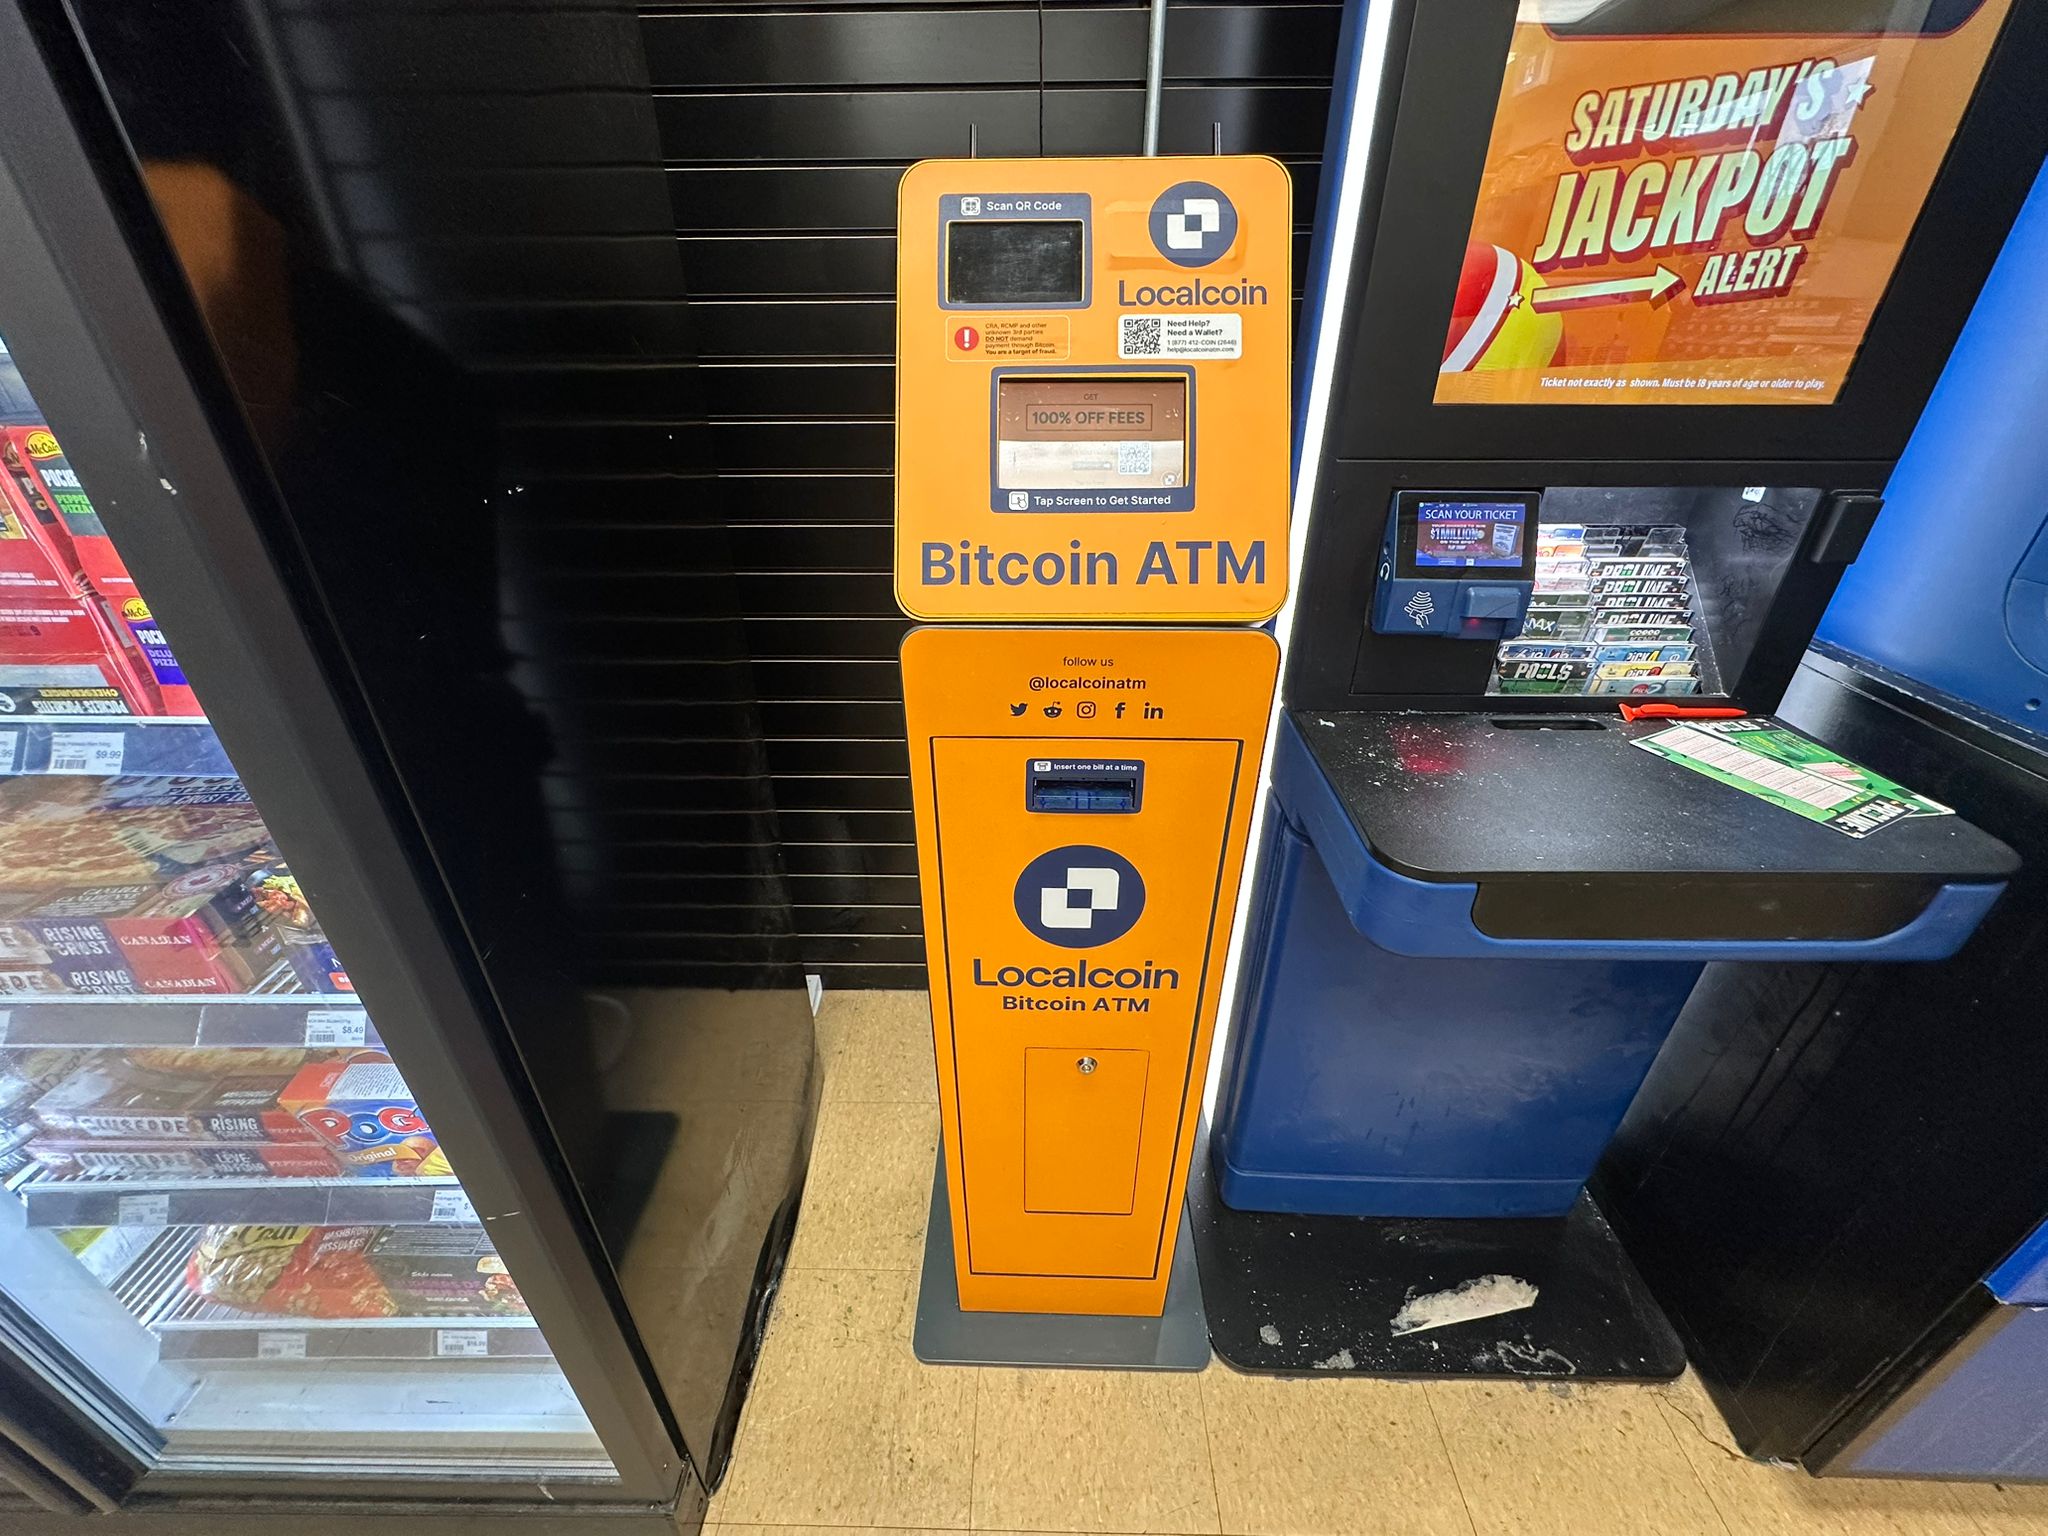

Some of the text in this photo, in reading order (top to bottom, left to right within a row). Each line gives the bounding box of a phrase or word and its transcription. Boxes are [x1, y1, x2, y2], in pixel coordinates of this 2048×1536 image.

[1565, 58, 1838, 163] SATURDAY'S
[986, 200, 1062, 212] Scan QR Code
[1532, 136, 1858, 270] JACKPOT
[1693, 245, 1807, 304] ALERT
[1118, 278, 1268, 307] Localcoin
[1188, 320, 1210, 328] Help?
[1540, 377, 1825, 389] Ticket not exactly as shown. Must be 18 years of age or older to play.
[1083, 393, 1098, 401] GET
[1032, 410, 1145, 426] 100% OFF FEES
[1034, 494, 1171, 507] Tap Screen to Get Started
[1425, 509, 1518, 520] SCAN YOUR TICKET
[921, 540, 1265, 586] Bitcoin ATM
[1062, 656, 1114, 667] follow us
[1515, 663, 1573, 681] POOLS
[1029, 677, 1146, 692] @localcoinatm
[96, 750, 121, 759] $9.99
[1054, 763, 1075, 771] Insert
[1093, 763, 1104, 771] bill
[1121, 764, 1138, 772] time
[43, 925, 105, 942] RISING
[120, 934, 193, 945] CANADIAN
[53, 940, 112, 956] CRUST
[72, 969, 131, 986] RISING
[973, 958, 1179, 990] Localcoin
[145, 976, 217, 988] CANADIAN
[1002, 995, 1150, 1012] Bitcoin ATM
[342, 1026, 363, 1034] $8.49
[211, 1116, 258, 1131] RISING
[352, 1147, 397, 1163] Original
